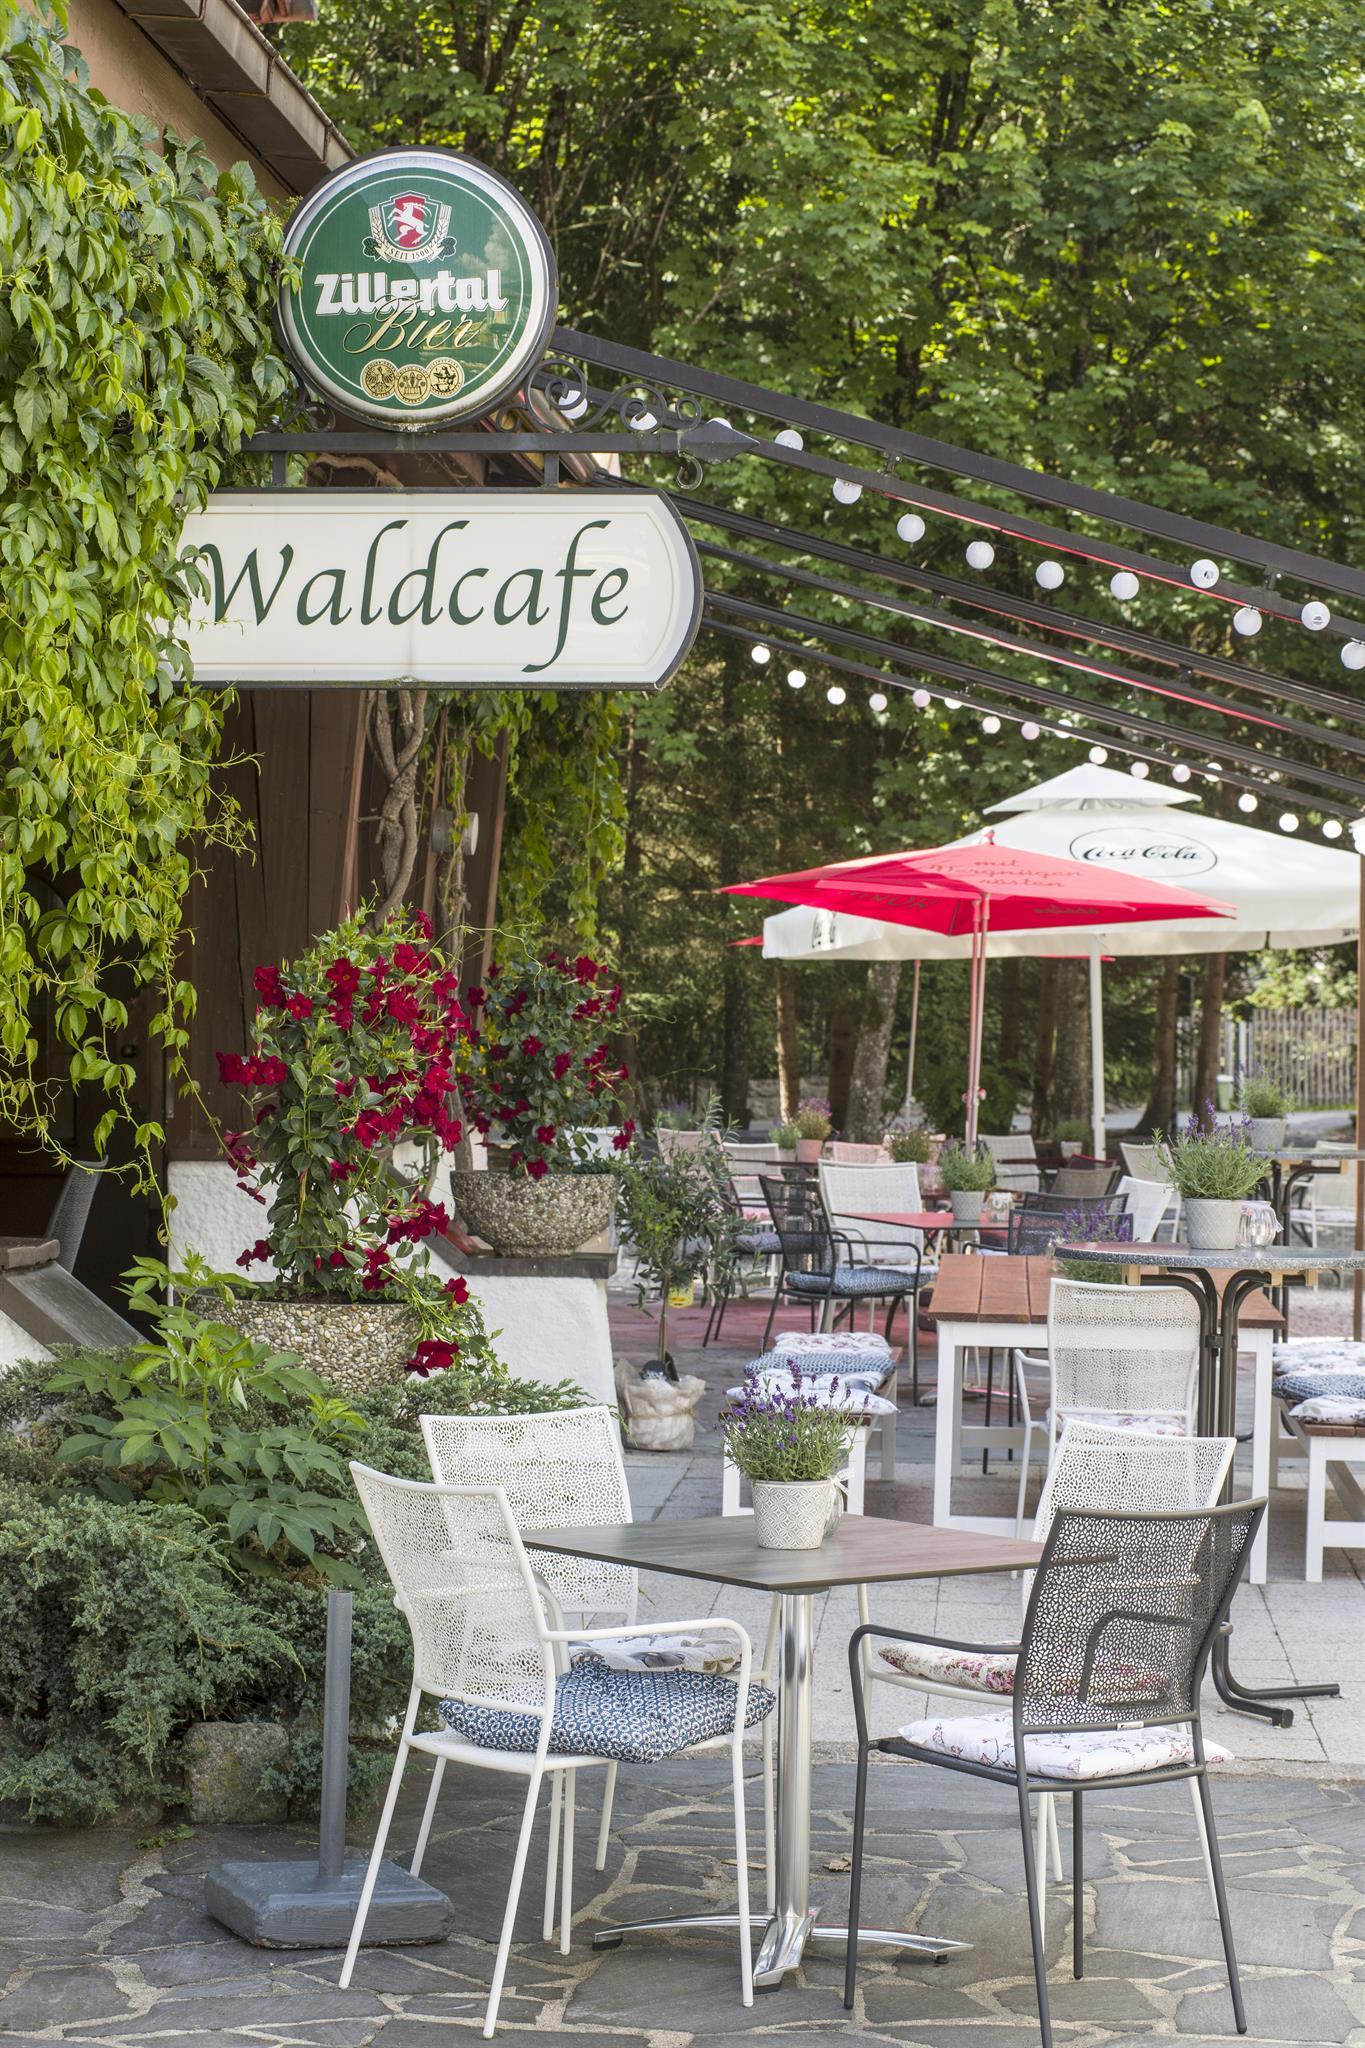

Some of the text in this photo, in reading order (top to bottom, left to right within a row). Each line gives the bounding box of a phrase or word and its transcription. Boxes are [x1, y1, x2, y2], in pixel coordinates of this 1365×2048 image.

[389, 248, 430, 260] SEIT 1500
[314, 269, 510, 316] Zillertal
[343, 294, 486, 354] Bier
[193, 519, 630, 673] Waldcafe
